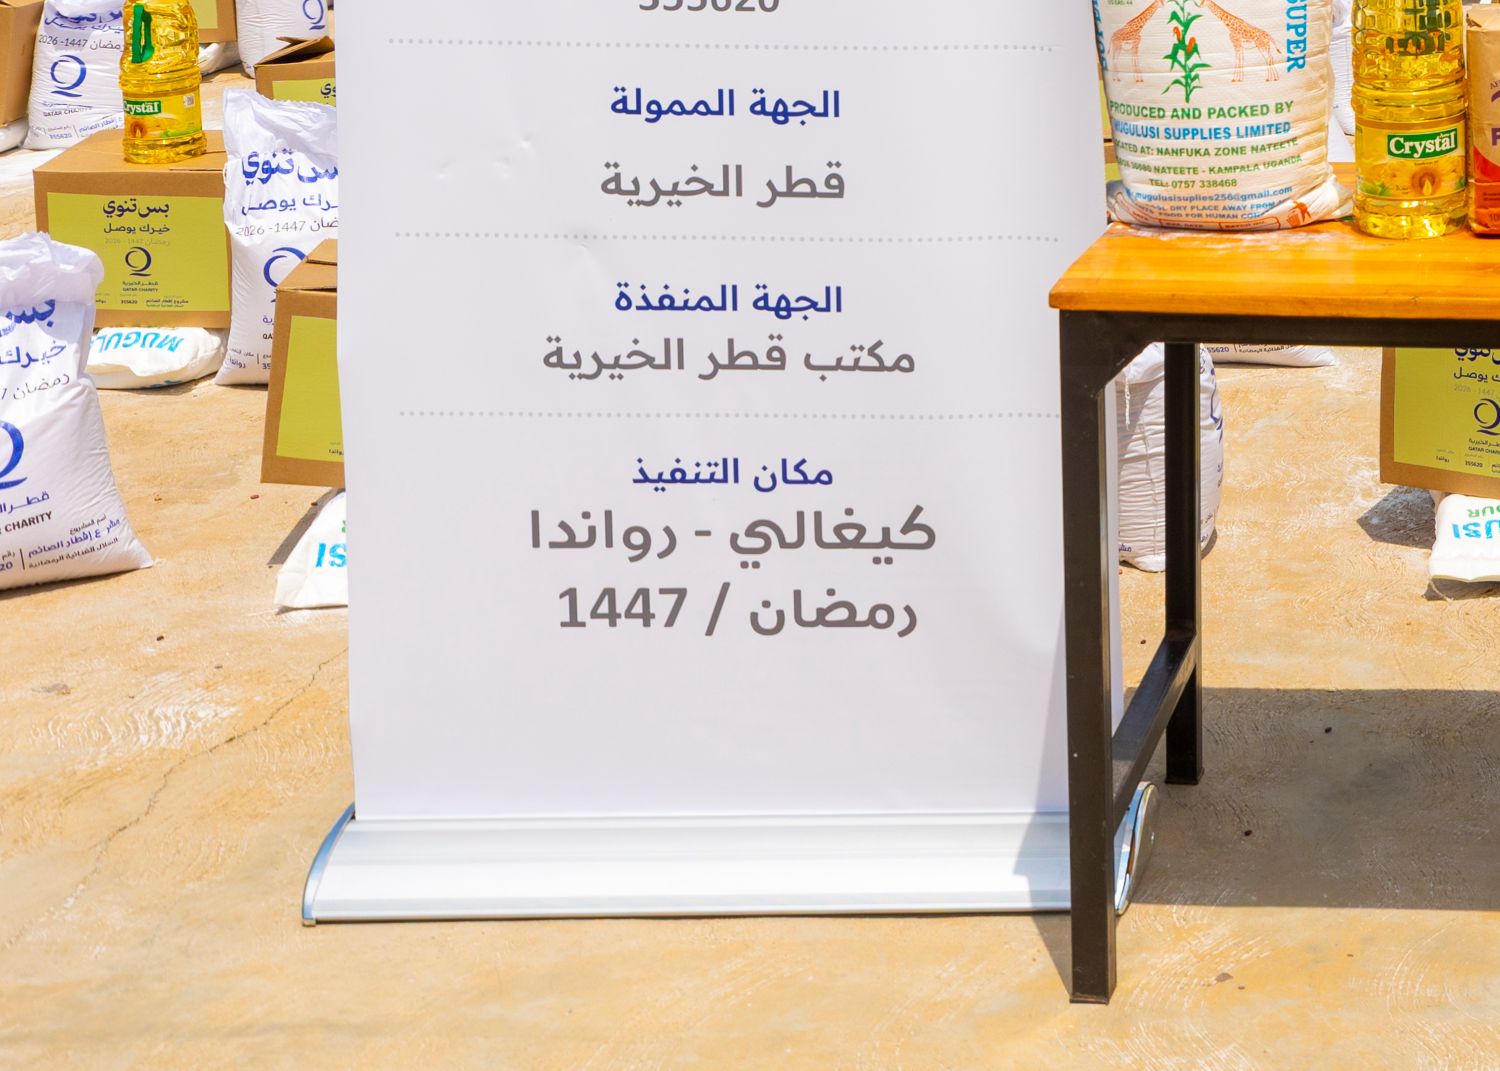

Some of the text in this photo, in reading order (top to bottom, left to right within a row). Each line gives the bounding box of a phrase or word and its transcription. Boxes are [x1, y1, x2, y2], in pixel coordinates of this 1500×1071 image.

[610, 86, 841, 127] الجهة الممولة
[1109, 100, 1294, 120] PRODUCED AND PACKED BY
[1164, 126, 1231, 141] SUPPLIES
[1236, 121, 1291, 139] LIMITED
[1156, 147, 1211, 157] NANFUKA
[1214, 146, 1246, 157] ZONE
[1389, 132, 1455, 158] Crystal
[242, 148, 294, 186] تنوي
[1153, 166, 1199, 175] NATEETE
[1208, 163, 1261, 174] KAMPALA
[600, 161, 846, 208] قطر الخيرية
[1171, 180, 1195, 188] 0757
[1199, 178, 1237, 188] 338468
[103, 198, 170, 218] بس تنوي
[104, 223, 170, 234] خيرك يوصل
[614, 282, 843, 320] الجهة المنفذة
[542, 334, 916, 382] مكتب قطر الخيرية
[12, 373, 69, 400] رمضان
[1453, 367, 1488, 383] يوصل
[632, 457, 834, 494] مكان التنفيذ
[4, 510, 52, 532] CHARITY
[529, 510, 678, 562] رواندا
[729, 505, 937, 569] كيغالي
[559, 587, 688, 629] 1447
[749, 589, 918, 637] رمضان
